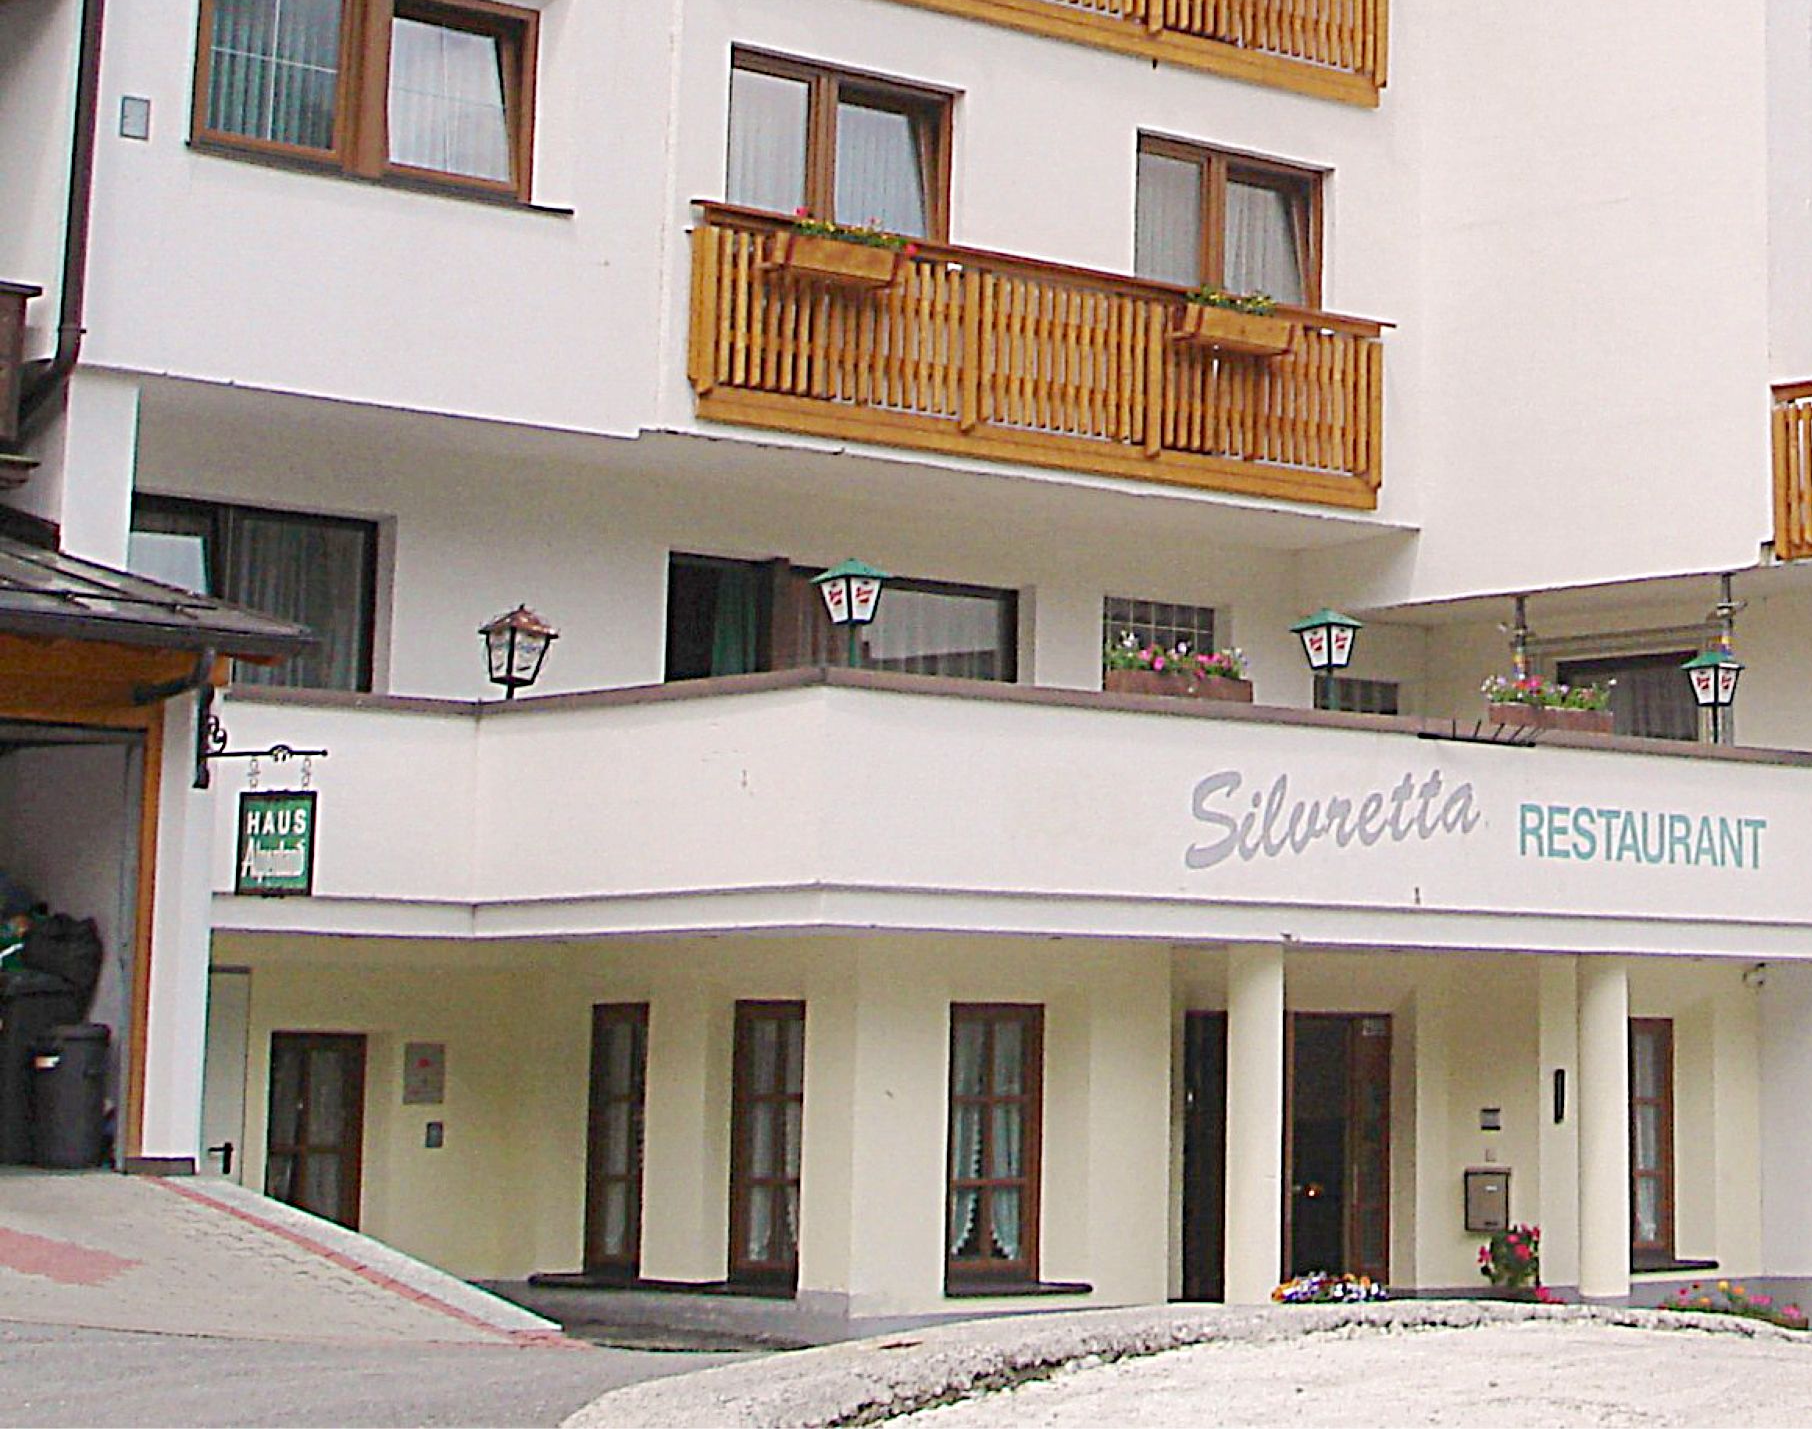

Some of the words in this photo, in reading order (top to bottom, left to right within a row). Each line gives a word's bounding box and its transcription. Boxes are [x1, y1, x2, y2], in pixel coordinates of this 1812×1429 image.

[246, 808, 308, 835] HAUS
[1185, 769, 1481, 870] Silvretta
[1519, 803, 1767, 870] RESTAURANT
